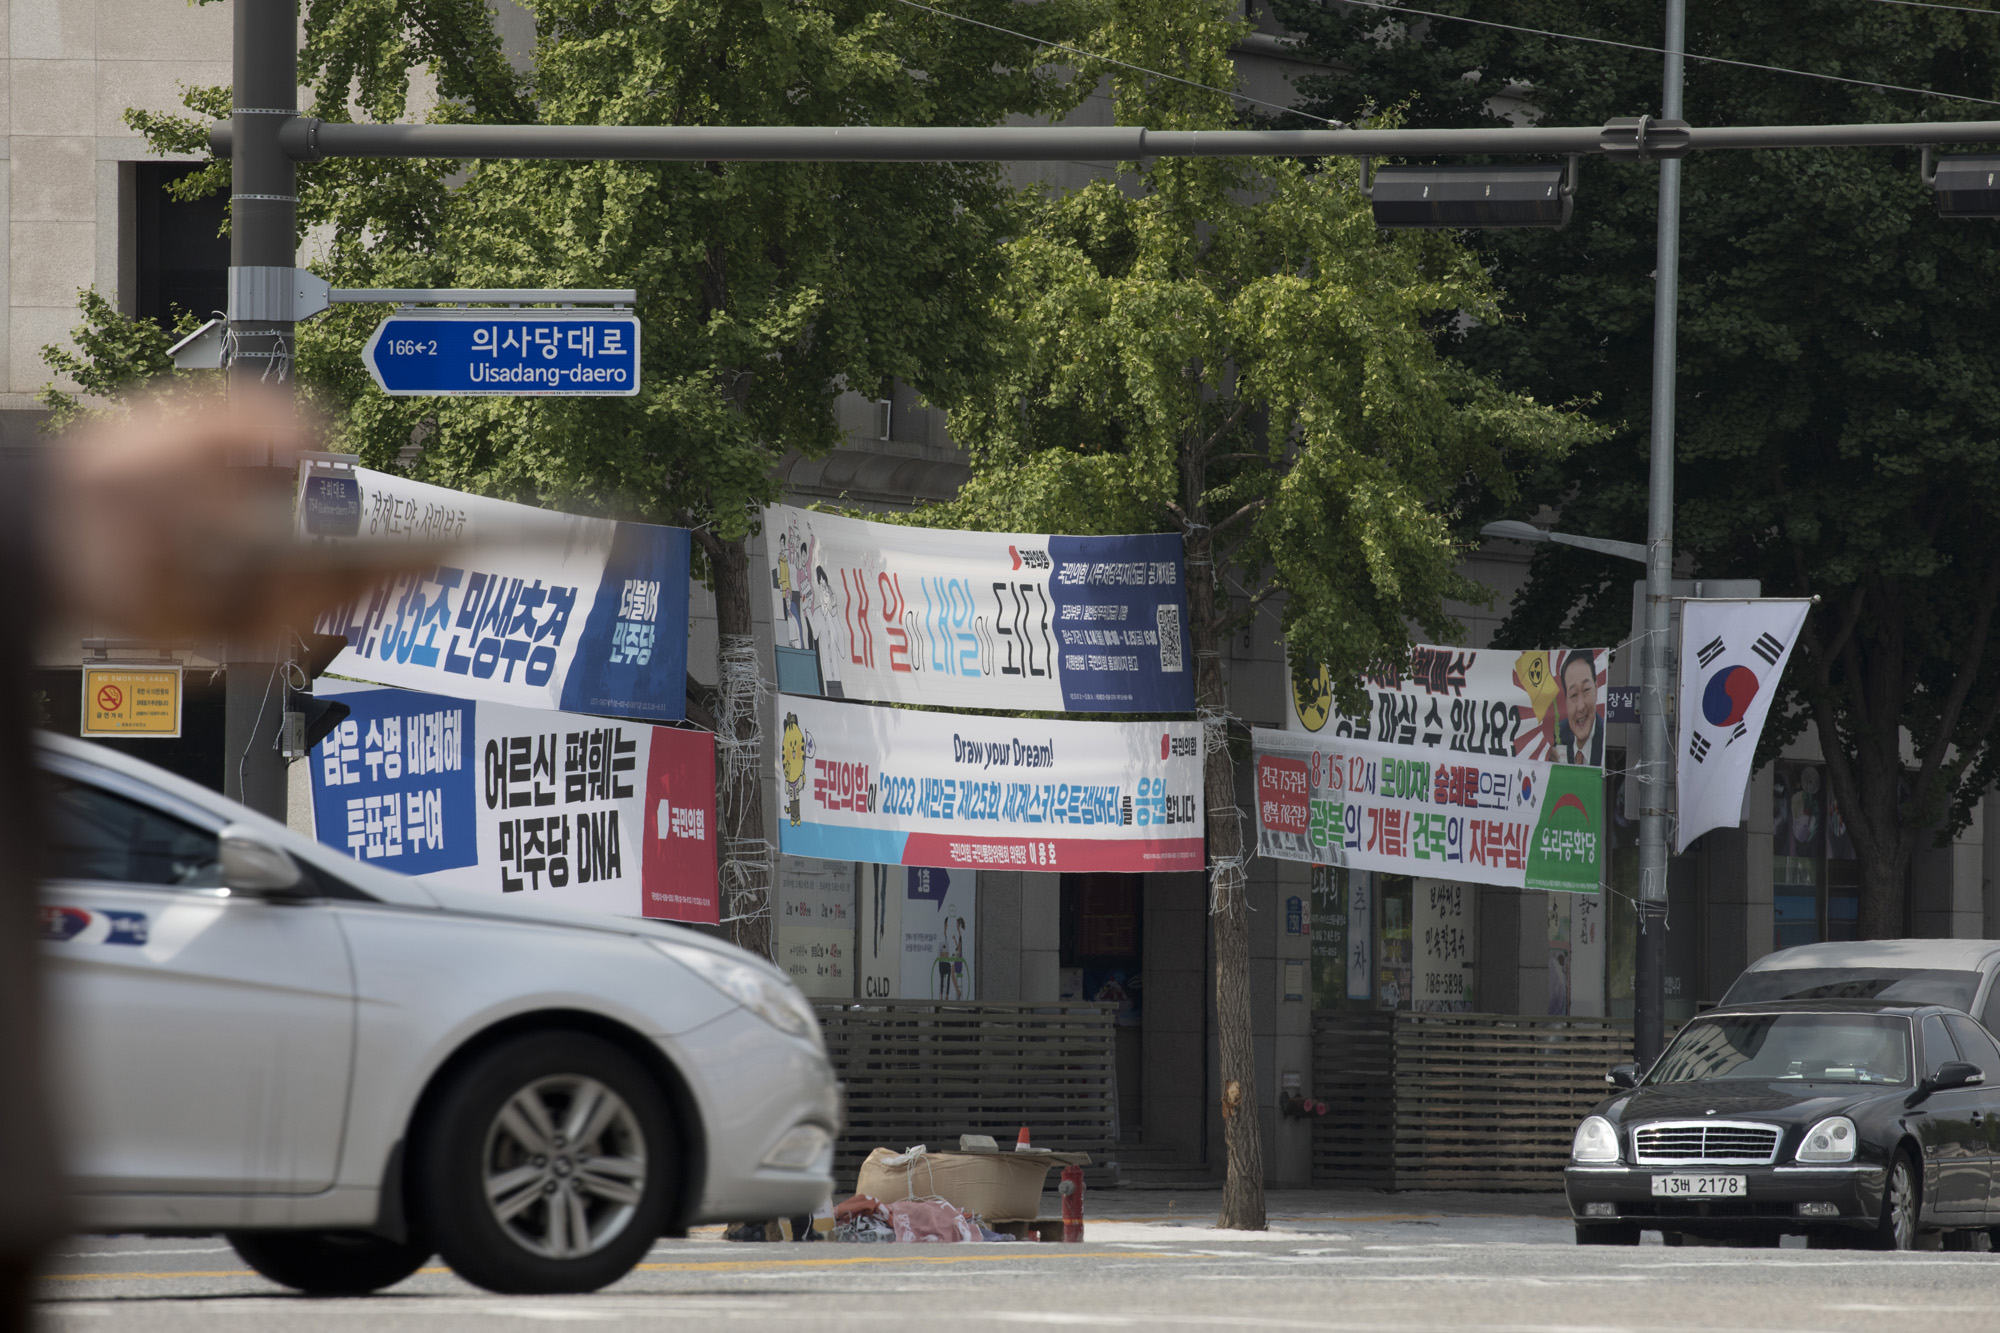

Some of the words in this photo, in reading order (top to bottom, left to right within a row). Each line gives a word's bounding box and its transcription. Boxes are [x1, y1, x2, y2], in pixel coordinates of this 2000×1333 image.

[471, 326, 627, 360] 의사당대로
[469, 362, 627, 386] Uisadang-daero
[319, 480, 346, 499] 국회대로
[1019, 550, 1050, 569] 국민의힘
[1058, 562, 1089, 585] 국민의힘
[1148, 562, 1176, 585] 공개채용
[618, 579, 660, 622] 더불어
[444, 571, 578, 687] 민생추경
[609, 622, 655, 665] 민주당
[993, 581, 1052, 680] 되다
[1088, 655, 1108, 671] 국민의힘
[1608, 692, 1633, 707] 장실
[1378, 692, 1417, 745] 마실
[1422, 697, 1443, 748] 수
[1449, 698, 1521, 757] 있나요?
[322, 720, 360, 786] 남은
[365, 716, 402, 782] 수명
[407, 709, 462, 775] 비례해
[953, 733, 983, 763] Draw
[984, 743, 1011, 770] your
[1012, 737, 1054, 768] Dream!
[1171, 737, 1197, 757] 국민의힘
[485, 733, 557, 810] 어르신
[565, 727, 636, 804] 폄훼는
[1262, 766, 1278, 788] 건국
[1280, 770, 1307, 794] 75주년
[1348, 756, 1376, 795] 12시
[1380, 757, 1430, 803] 모이자!
[1434, 763, 1513, 811] 숭례문으로!
[813, 759, 877, 814] 국민의힘이
[917, 777, 956, 820] 새만금
[957, 780, 1000, 822] 제25회
[1135, 777, 1196, 827] 응원합니다
[346, 793, 403, 862] 투표권
[406, 788, 444, 854] 부여
[671, 807, 705, 840] 국민의힘
[1262, 801, 1279, 823] 광복
[1280, 804, 1307, 828] 78주년
[499, 814, 570, 893] 민주당
[576, 810, 622, 884] DNA
[1310, 800, 1361, 852] 광복의
[1367, 808, 1411, 857] 기쁨!
[1412, 812, 1464, 863] 건국의
[1469, 819, 1530, 870] 자부심!
[1540, 827, 1596, 864] 우리공화당
[949, 843, 972, 862] 국민의힘
[972, 844, 1010, 864] 국민통합위원회
[1010, 845, 1027, 865] 위원장
[1661, 1178, 1690, 1193] 13버
[1698, 1178, 1738, 1193] 2178
